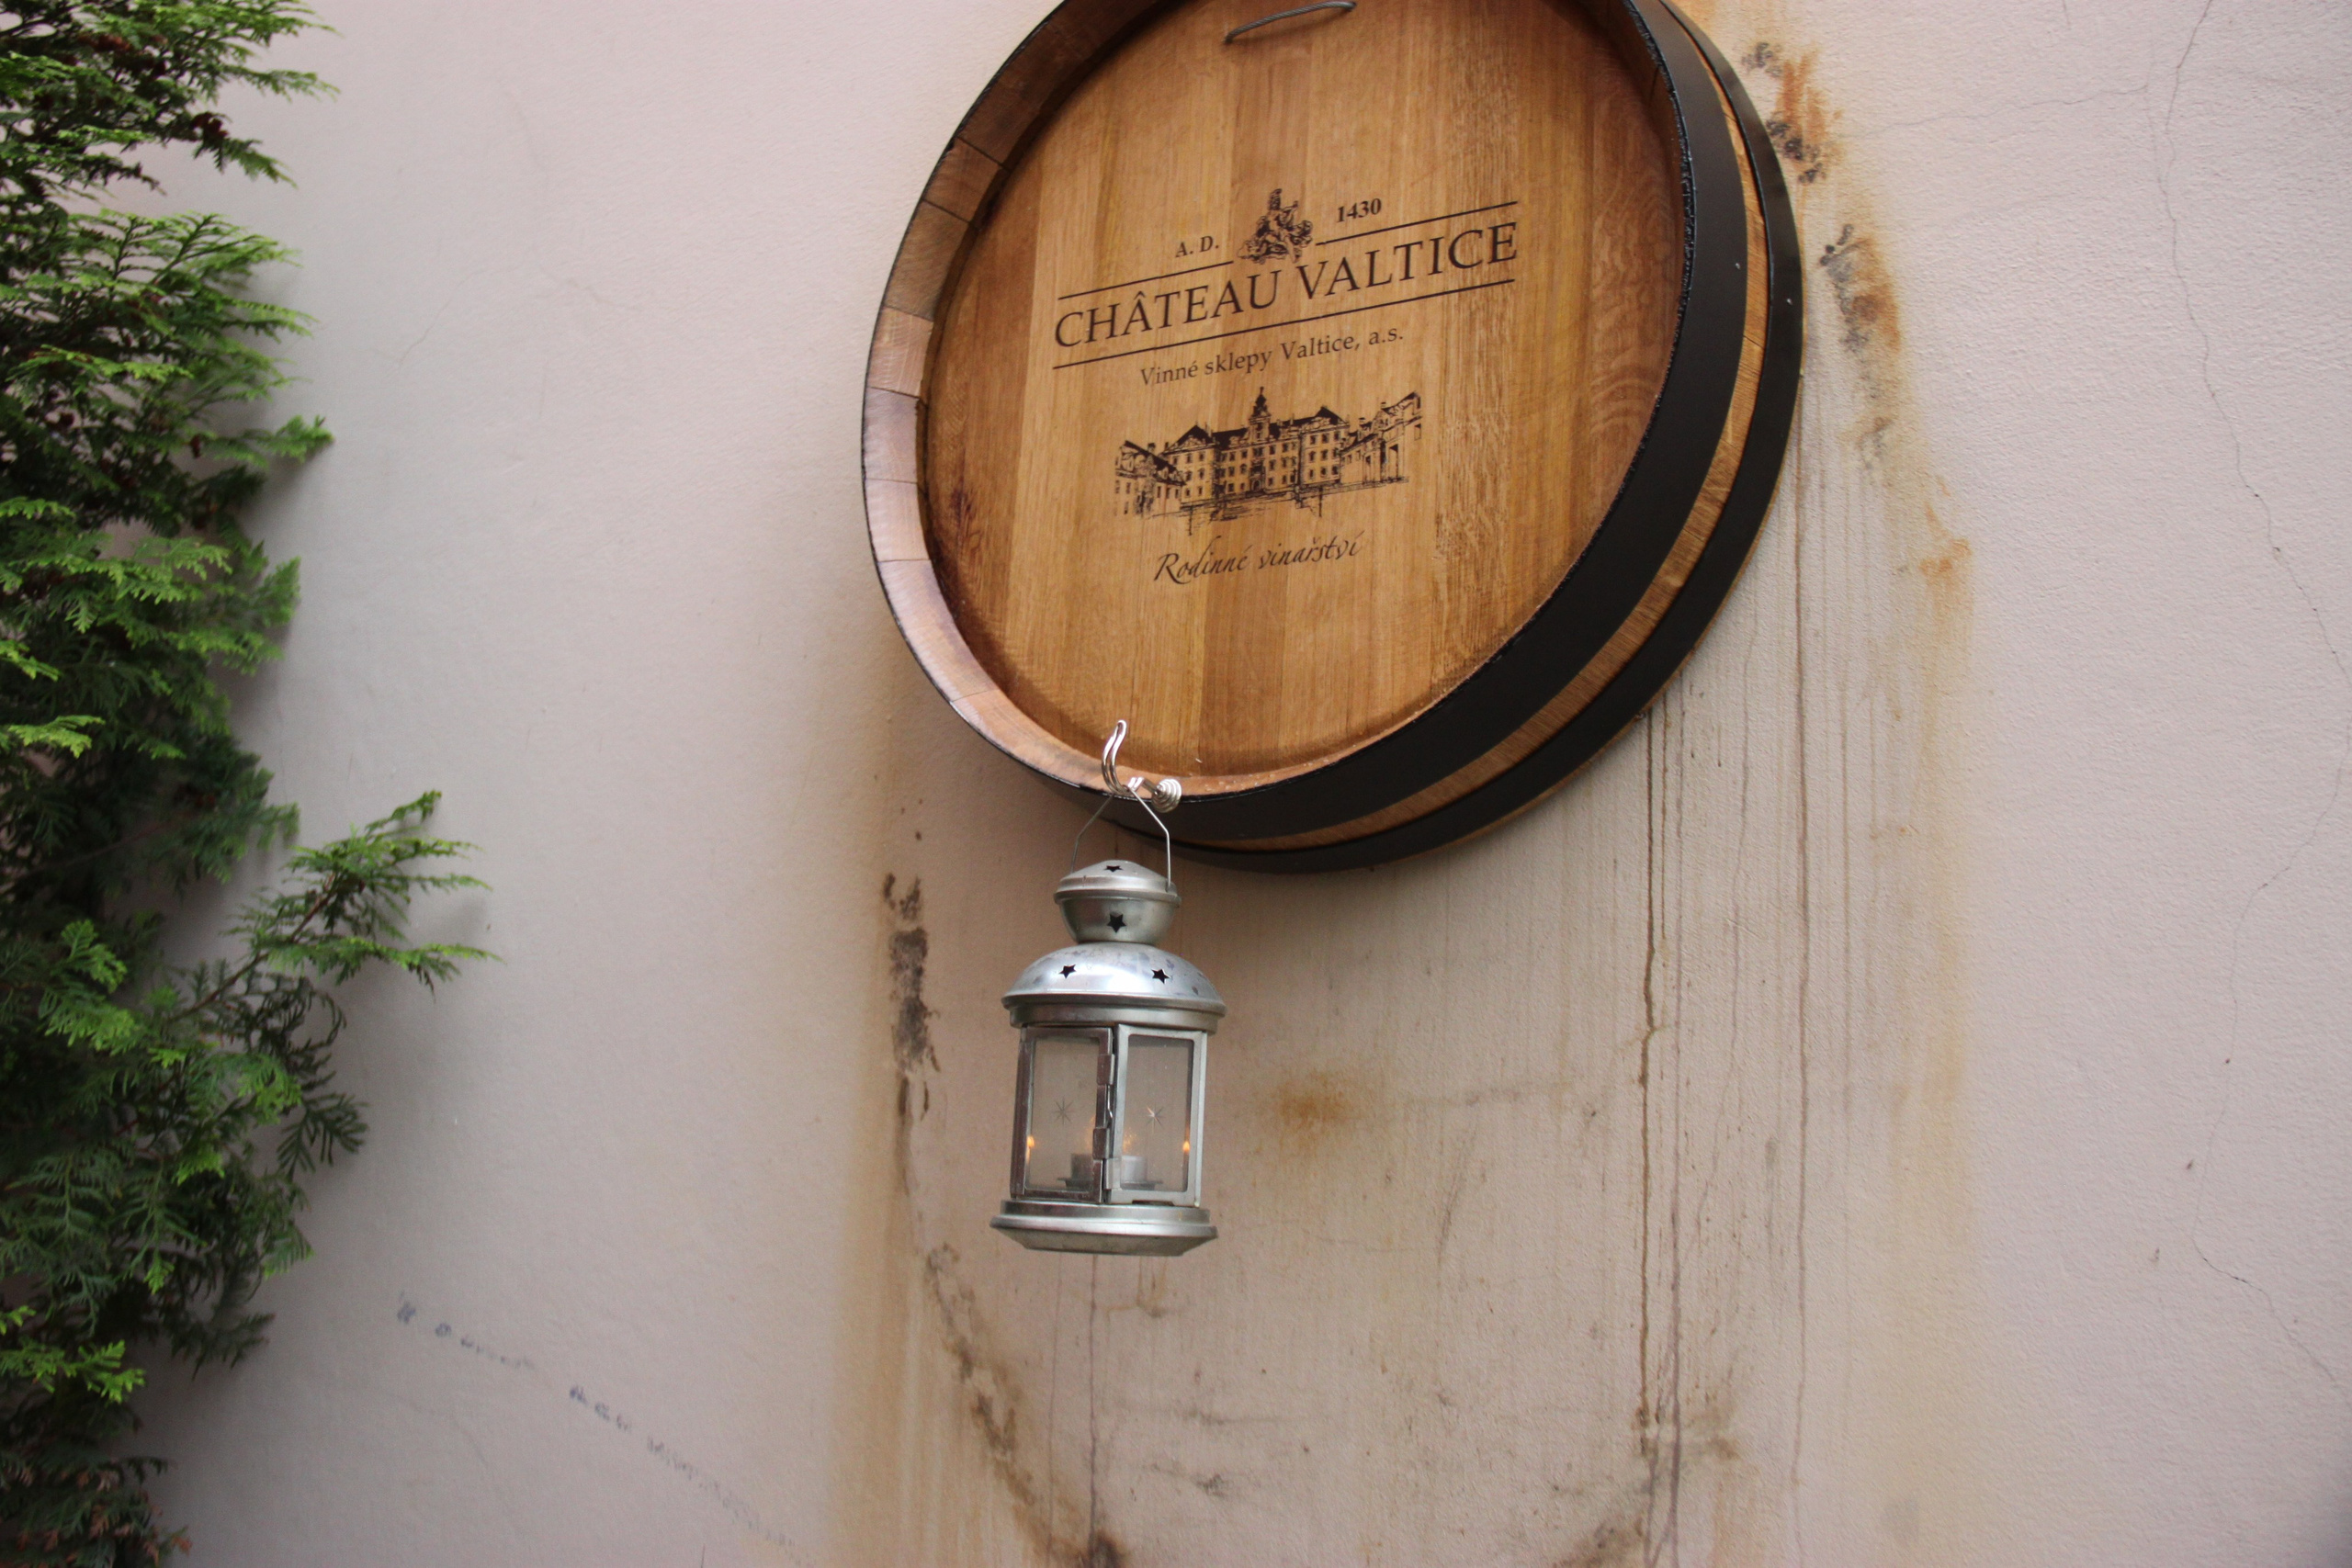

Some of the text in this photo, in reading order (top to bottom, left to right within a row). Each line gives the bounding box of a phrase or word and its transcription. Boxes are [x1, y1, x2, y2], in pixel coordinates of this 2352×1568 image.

[1174, 197, 1382, 258] A. D. 1430
[1054, 221, 1518, 348] CHÂTEAU VALTICE
[1139, 326, 1404, 387] Vinné sklepy Valtice, a.s.
[1153, 530, 1365, 585] Rodinné vinařství
